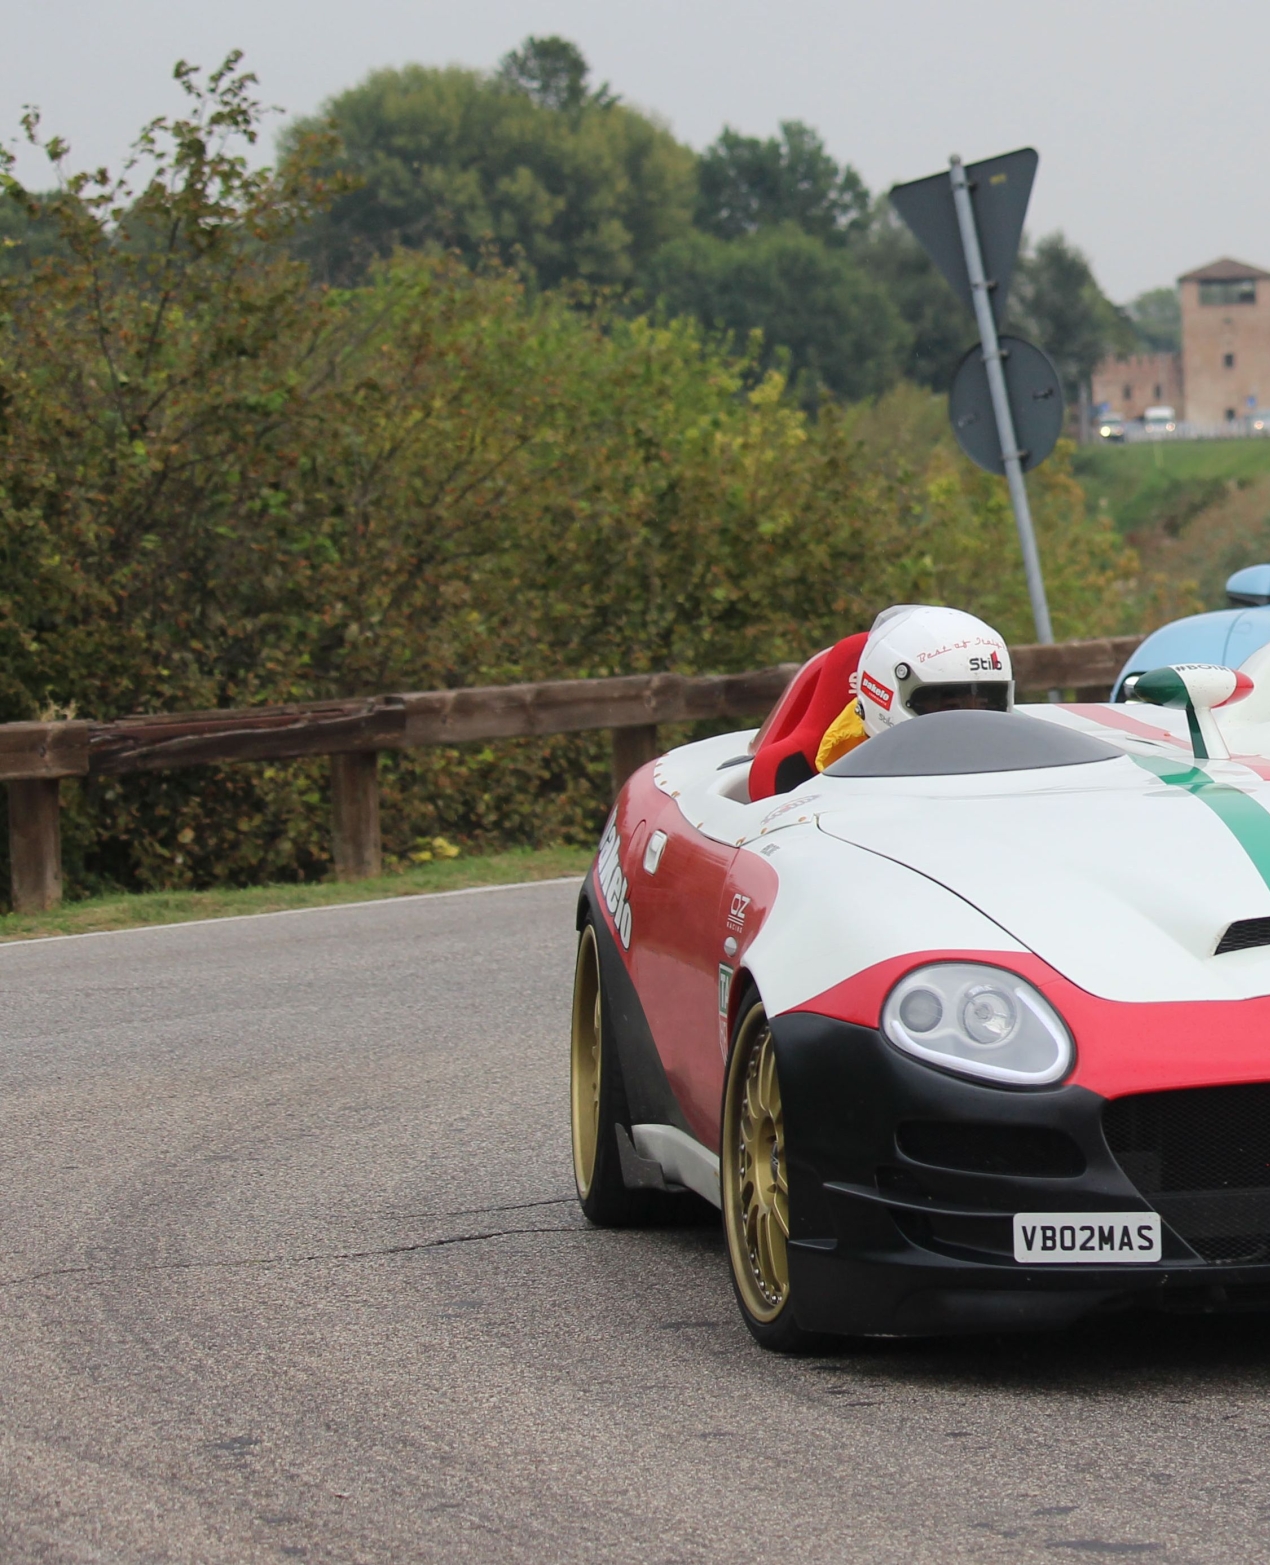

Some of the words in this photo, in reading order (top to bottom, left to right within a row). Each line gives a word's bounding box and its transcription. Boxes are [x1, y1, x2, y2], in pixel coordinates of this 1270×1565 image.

[916, 645, 952, 663] Best
[953, 639, 971, 649] of
[969, 650, 1003, 671] Stilo
[730, 893, 751, 919] OZ
[726, 921, 743, 934] RACING
